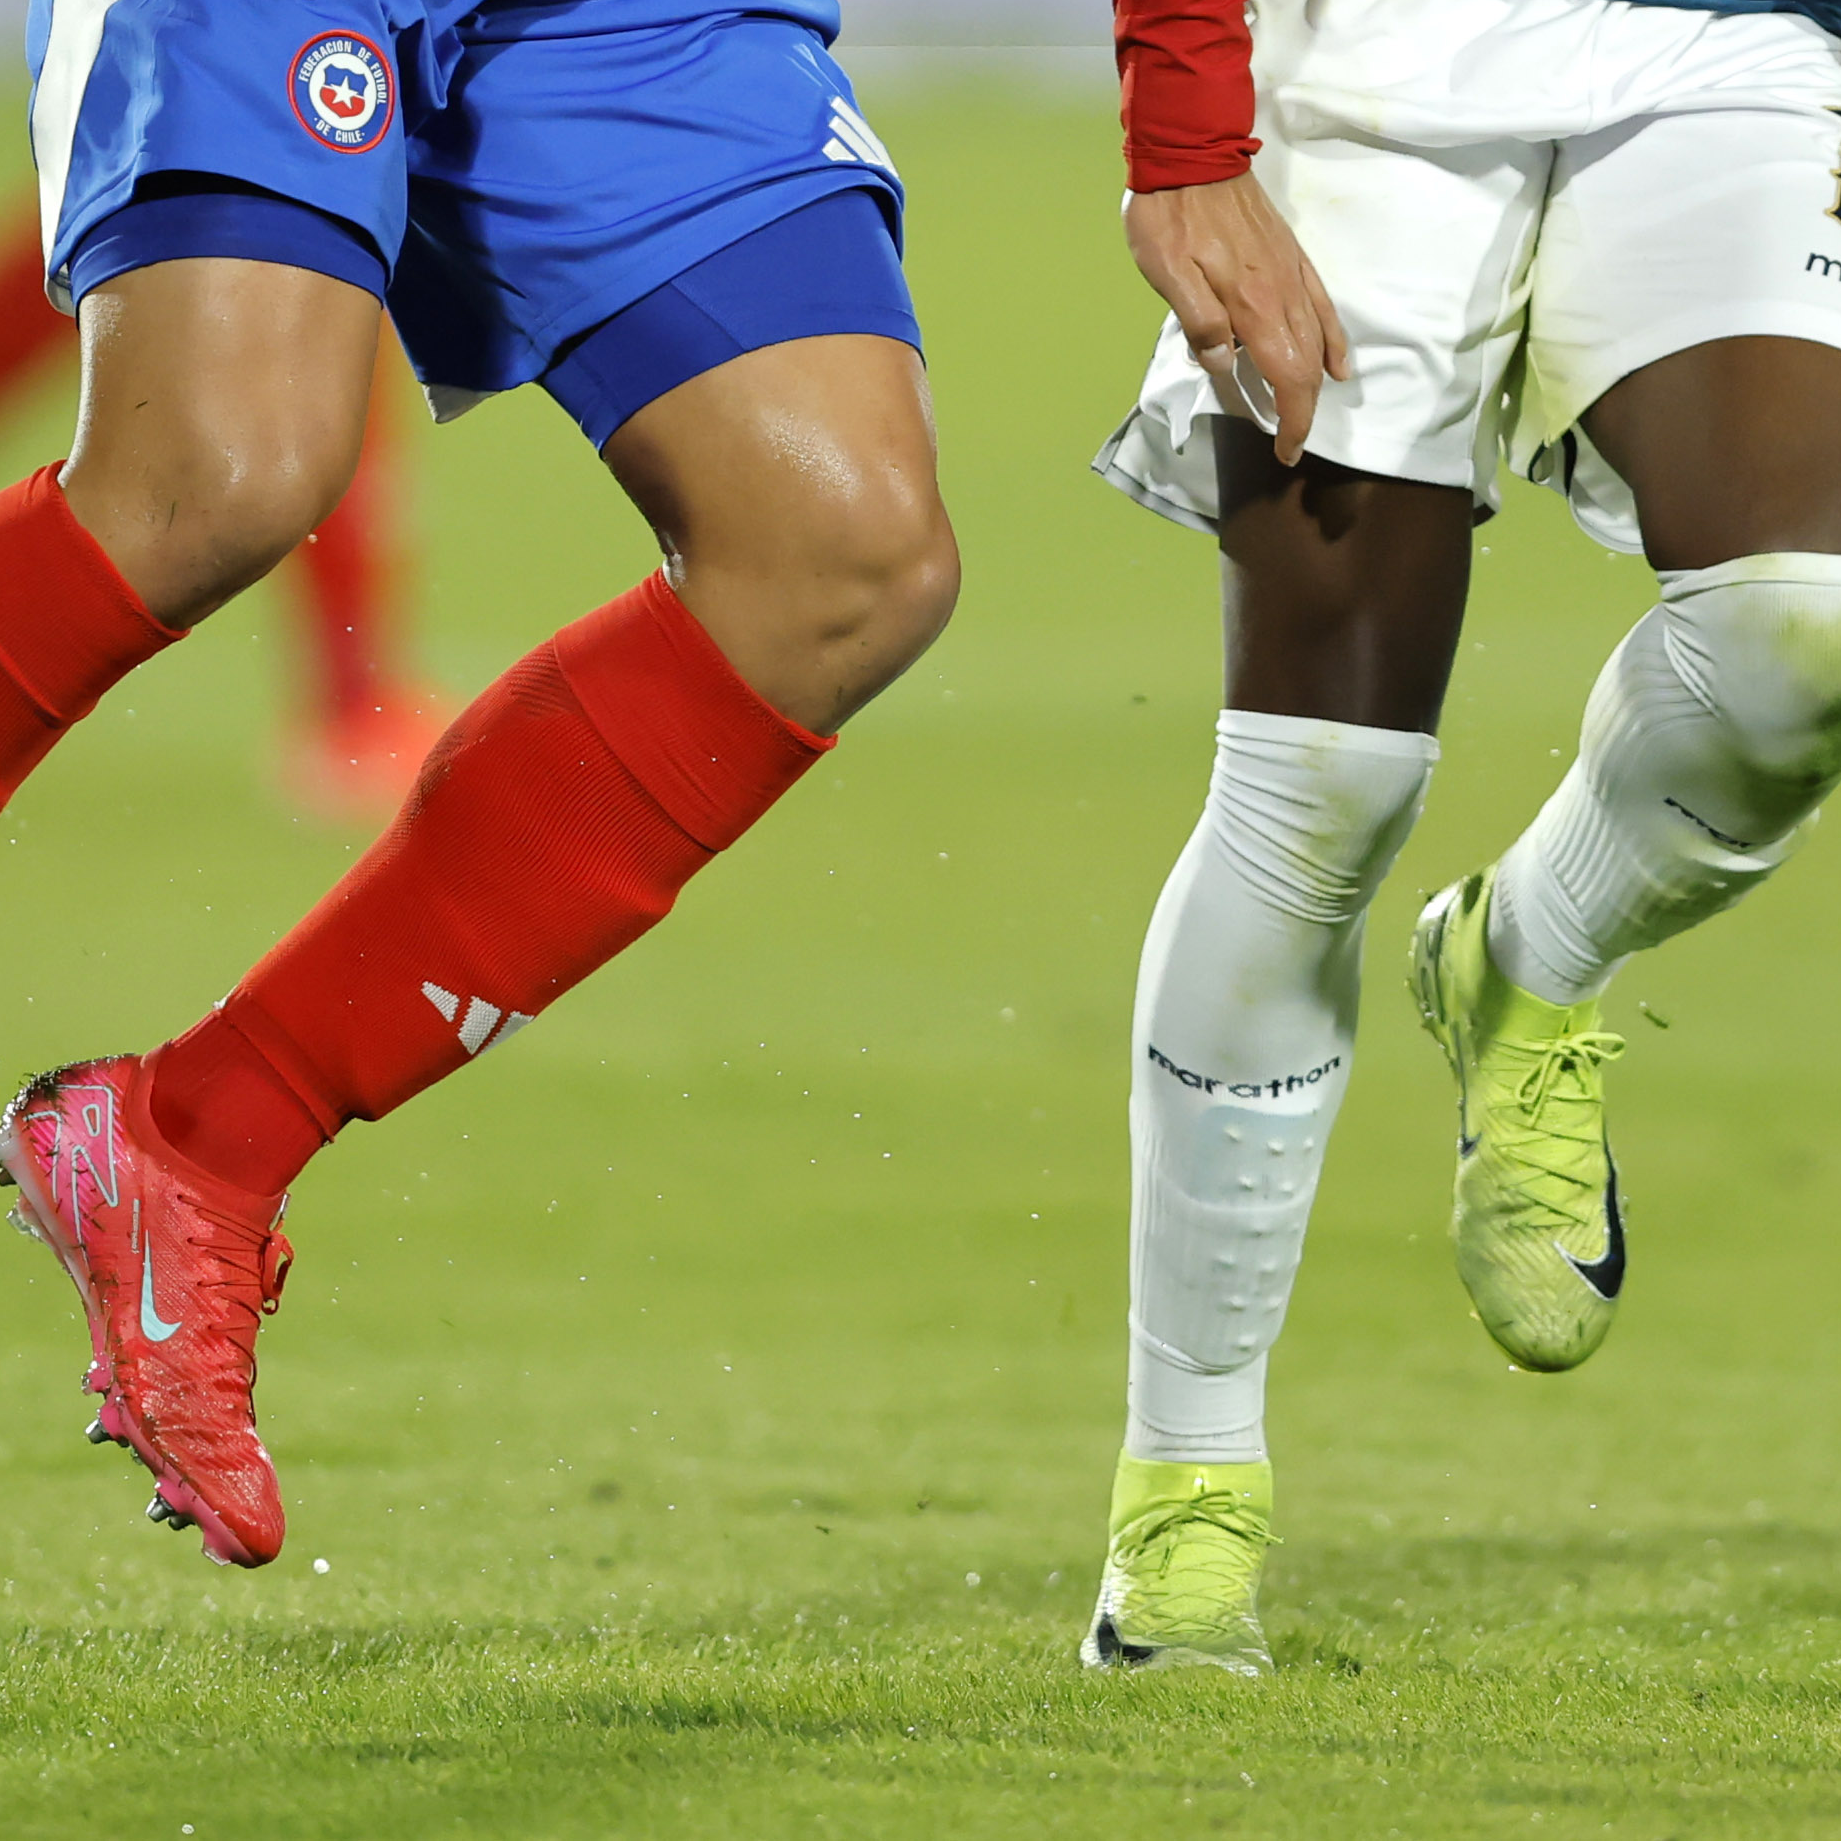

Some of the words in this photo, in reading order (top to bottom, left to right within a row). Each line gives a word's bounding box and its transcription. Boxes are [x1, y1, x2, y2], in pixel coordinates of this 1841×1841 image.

[298, 39, 352, 83] FEDERACION
[357, 46, 372, 63] DE
[370, 62, 387, 105] FUTBOL
[315, 119, 331, 136] DE
[335, 130, 363, 144] CHILE
[1148, 1043, 1341, 1099] marathon
